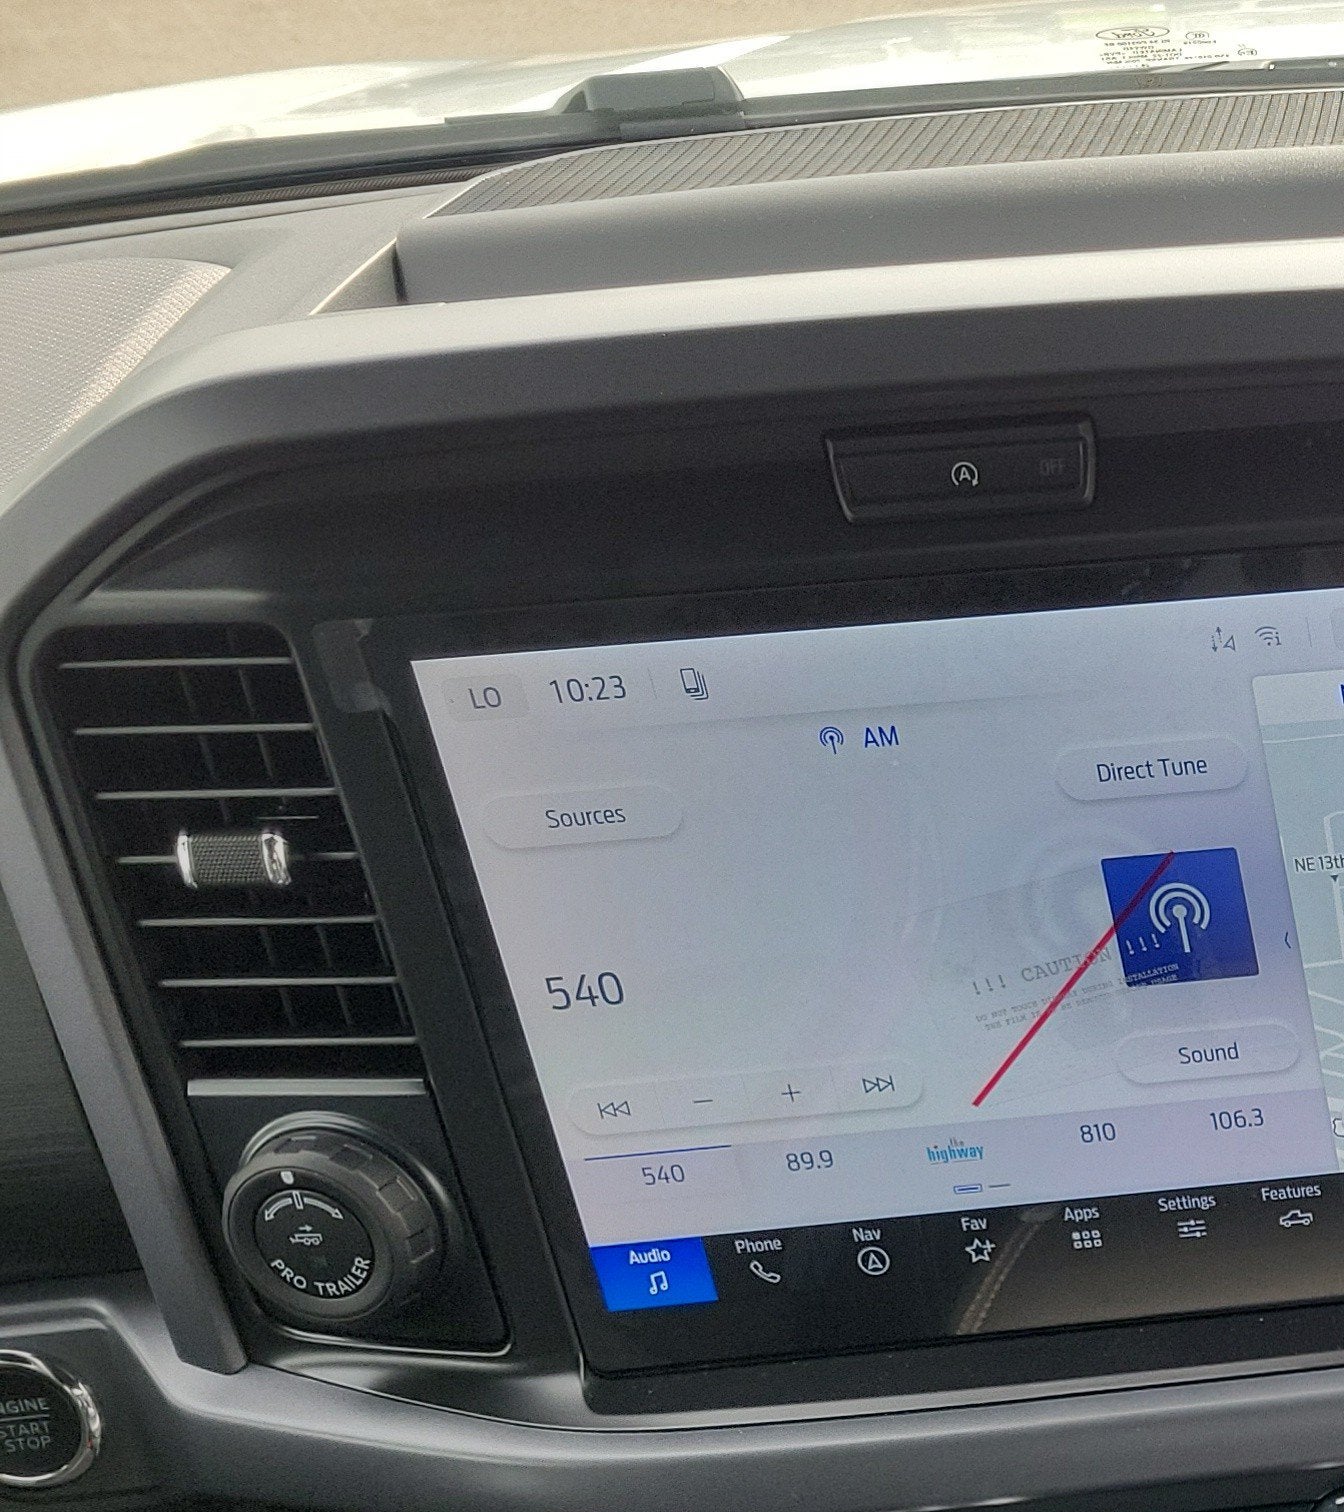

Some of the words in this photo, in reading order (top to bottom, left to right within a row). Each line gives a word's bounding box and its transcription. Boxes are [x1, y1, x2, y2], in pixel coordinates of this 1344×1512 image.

[469, 686, 502, 710] LO
[549, 675, 627, 704] 10:23
[863, 726, 899, 748] AM
[1096, 758, 1154, 783] Direct
[1157, 755, 1208, 778] Tune
[545, 806, 626, 829] Sources
[1294, 855, 1316, 872] NE
[545, 971, 625, 1011] 540
[1178, 1041, 1239, 1065] Sound
[1209, 1107, 1264, 1133] 106.3
[1079, 1121, 1117, 1144] 810
[786, 1149, 834, 1172] 89.9
[925, 1144, 984, 1163] highway
[641, 1163, 685, 1186] 540
[1261, 1182, 1322, 1202] Features
[1063, 1203, 1100, 1224] Apps
[1157, 1192, 1217, 1216] Settings
[852, 1226, 881, 1244] Nav
[961, 1215, 988, 1232] Fav
[629, 1247, 671, 1265] Audio
[734, 1235, 782, 1254] Phone
[270, 1259, 307, 1289] PRO
[313, 1256, 371, 1297] TRAILER
[4, 1435, 50, 1452] STOP
